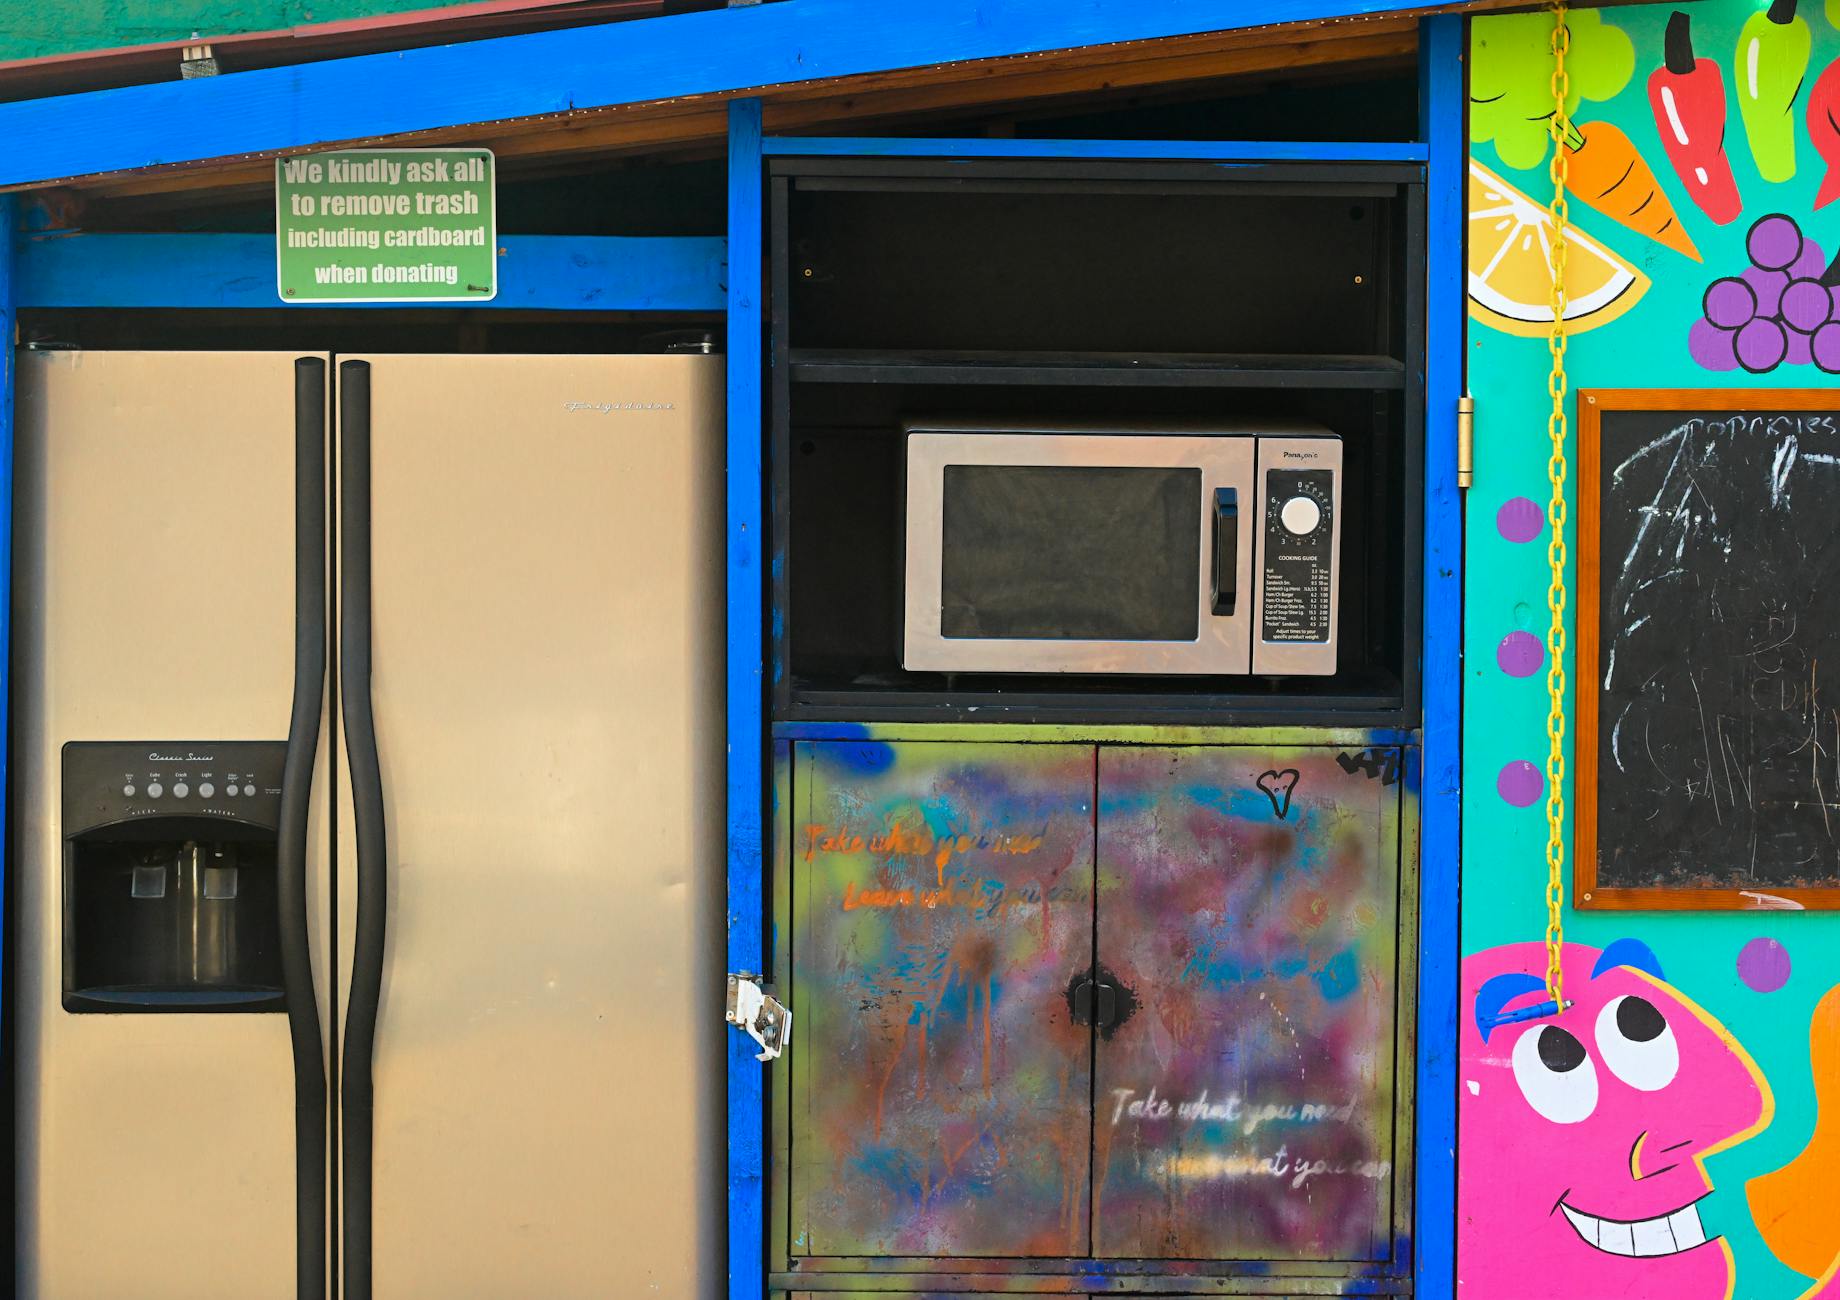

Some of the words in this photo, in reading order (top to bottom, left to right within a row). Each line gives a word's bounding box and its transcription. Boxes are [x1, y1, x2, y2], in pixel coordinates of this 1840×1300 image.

[285, 159, 322, 183] We
[328, 158, 401, 185] kindly
[406, 158, 449, 182] ask
[454, 157, 485, 182] all
[291, 193, 315, 216] to
[320, 194, 411, 216] remove
[415, 190, 479, 215] trash
[288, 227, 380, 249] including
[384, 226, 485, 247] cardboard
[314, 263, 368, 284] when
[371, 262, 458, 285] donating
[802, 825, 866, 864] Take
[1111, 1086, 1172, 1125] Take
[1177, 1089, 1242, 1121] what
[1243, 1101, 1297, 1135] you
[1292, 1156, 1346, 1189] you
